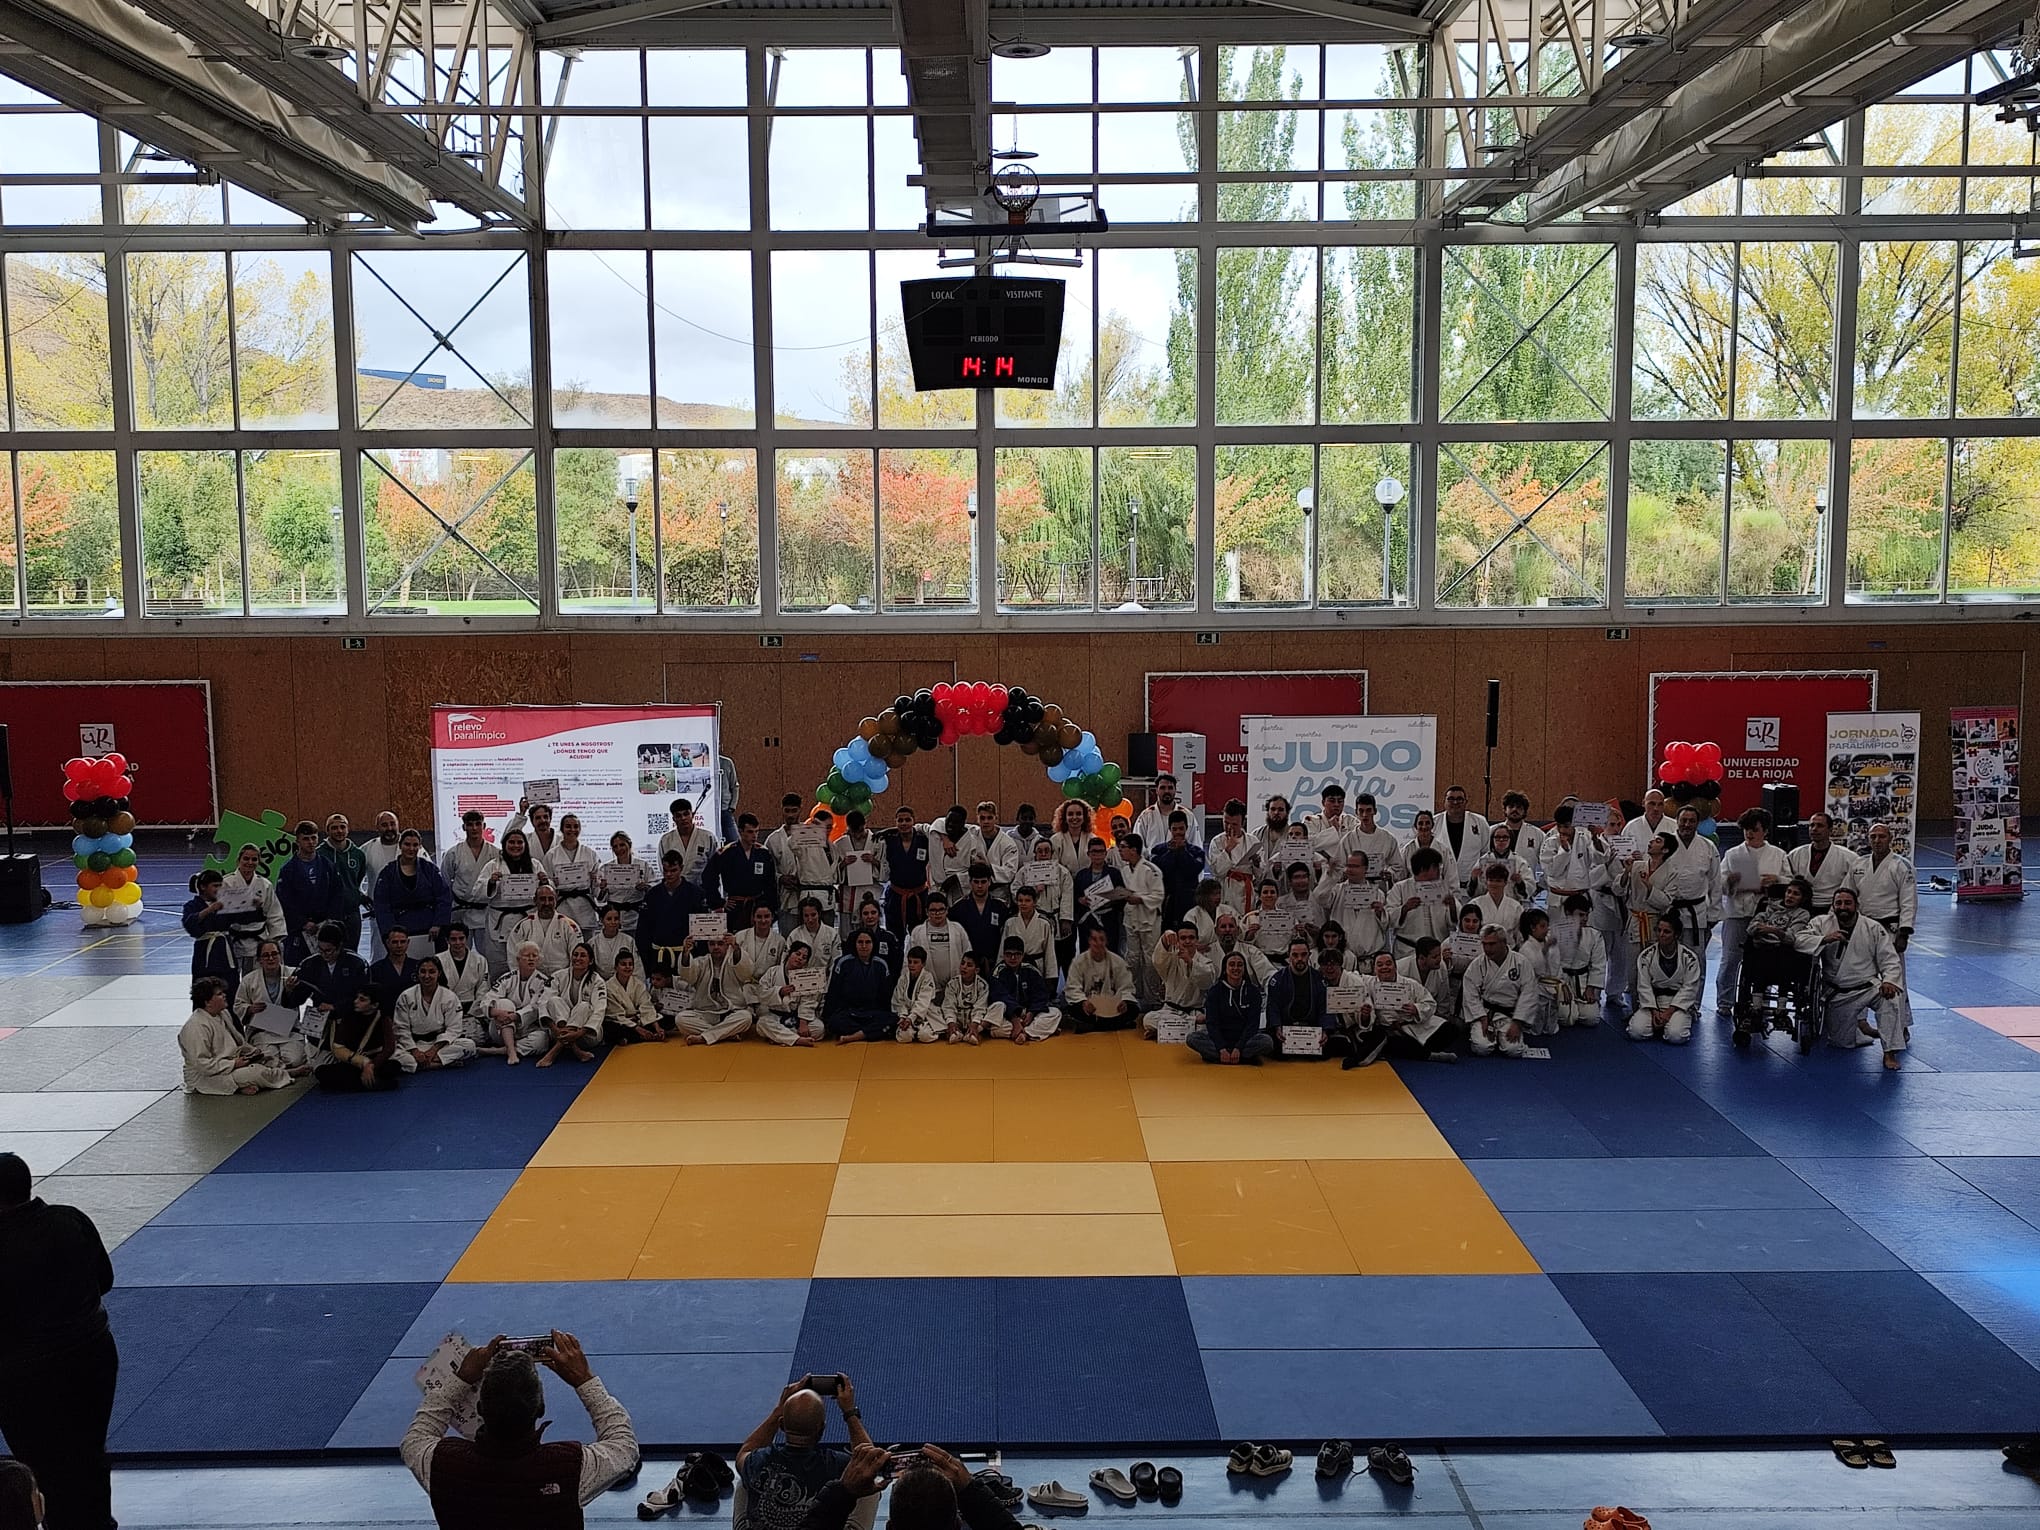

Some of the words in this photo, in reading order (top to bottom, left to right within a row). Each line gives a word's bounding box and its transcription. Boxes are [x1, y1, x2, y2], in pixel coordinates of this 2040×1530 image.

[931, 291, 955, 300] LOCAL
[1006, 290, 1044, 298] VISITANTE
[970, 335, 999, 343] PERIODO
[1017, 376, 1049, 384] MONDO
[453, 722, 482, 731] relevo
[1829, 728, 1899, 739] JORNADA
[1263, 741, 1421, 772] JUDO
[1723, 758, 1800, 767] UNIVERSIDAD
[1223, 765, 1239, 773] DE
[1728, 770, 1743, 778] DE
[1745, 770, 1760, 778] LA
[1762, 769, 1794, 780] RIOJA
